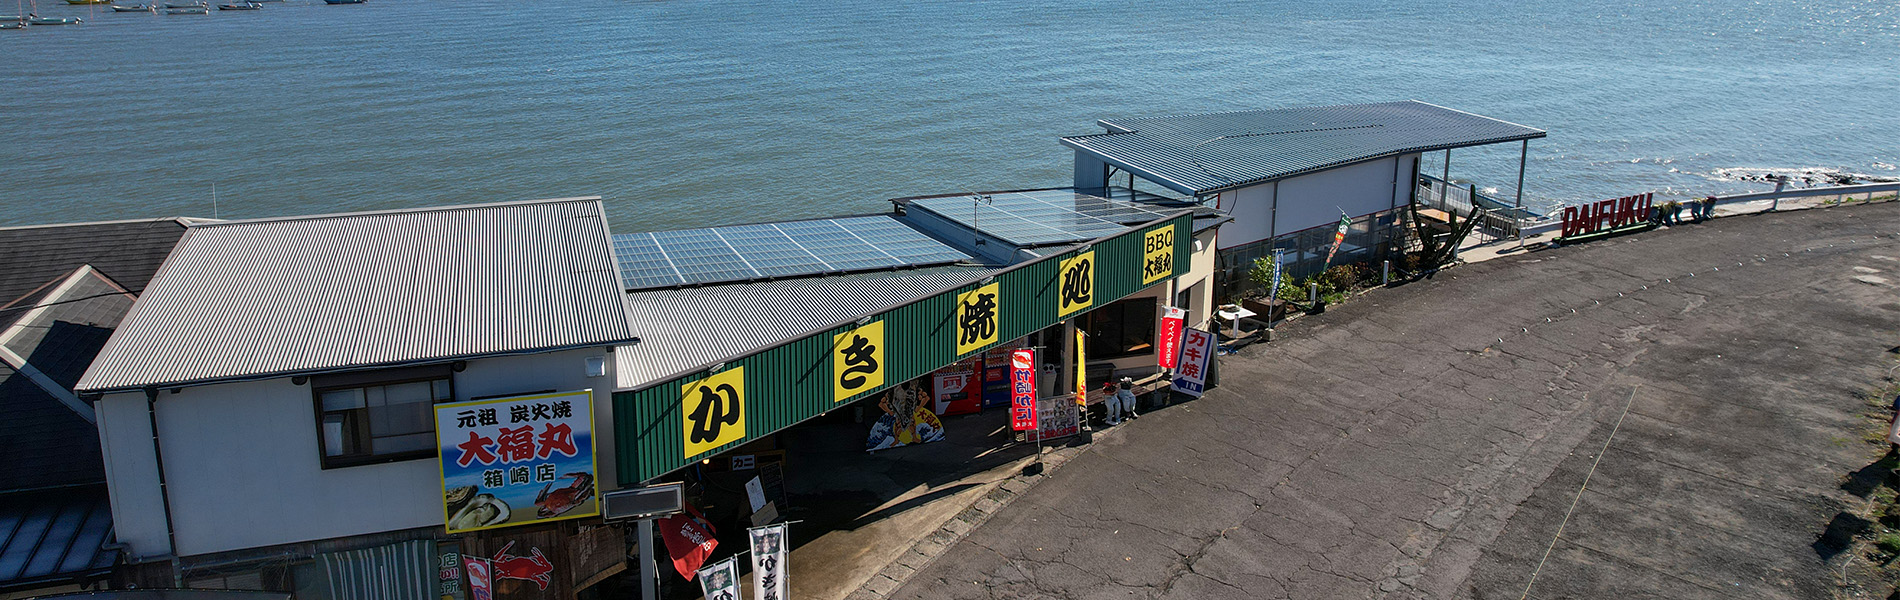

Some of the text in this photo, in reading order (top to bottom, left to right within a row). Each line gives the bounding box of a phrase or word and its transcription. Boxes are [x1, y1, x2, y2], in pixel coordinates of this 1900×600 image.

[1561, 193, 1653, 237] DAIFUKU
[1146, 230, 1173, 255] BBQ
[1144, 252, 1171, 280] 大福丸
[1181, 332, 1206, 379] カキ焼
[1185, 381, 1197, 390] IN
[457, 401, 572, 428] 元祖 炭火焼
[457, 423, 577, 466] 大福丸
[484, 464, 555, 488] 箱崎店
[733, 457, 754, 469] カニ
